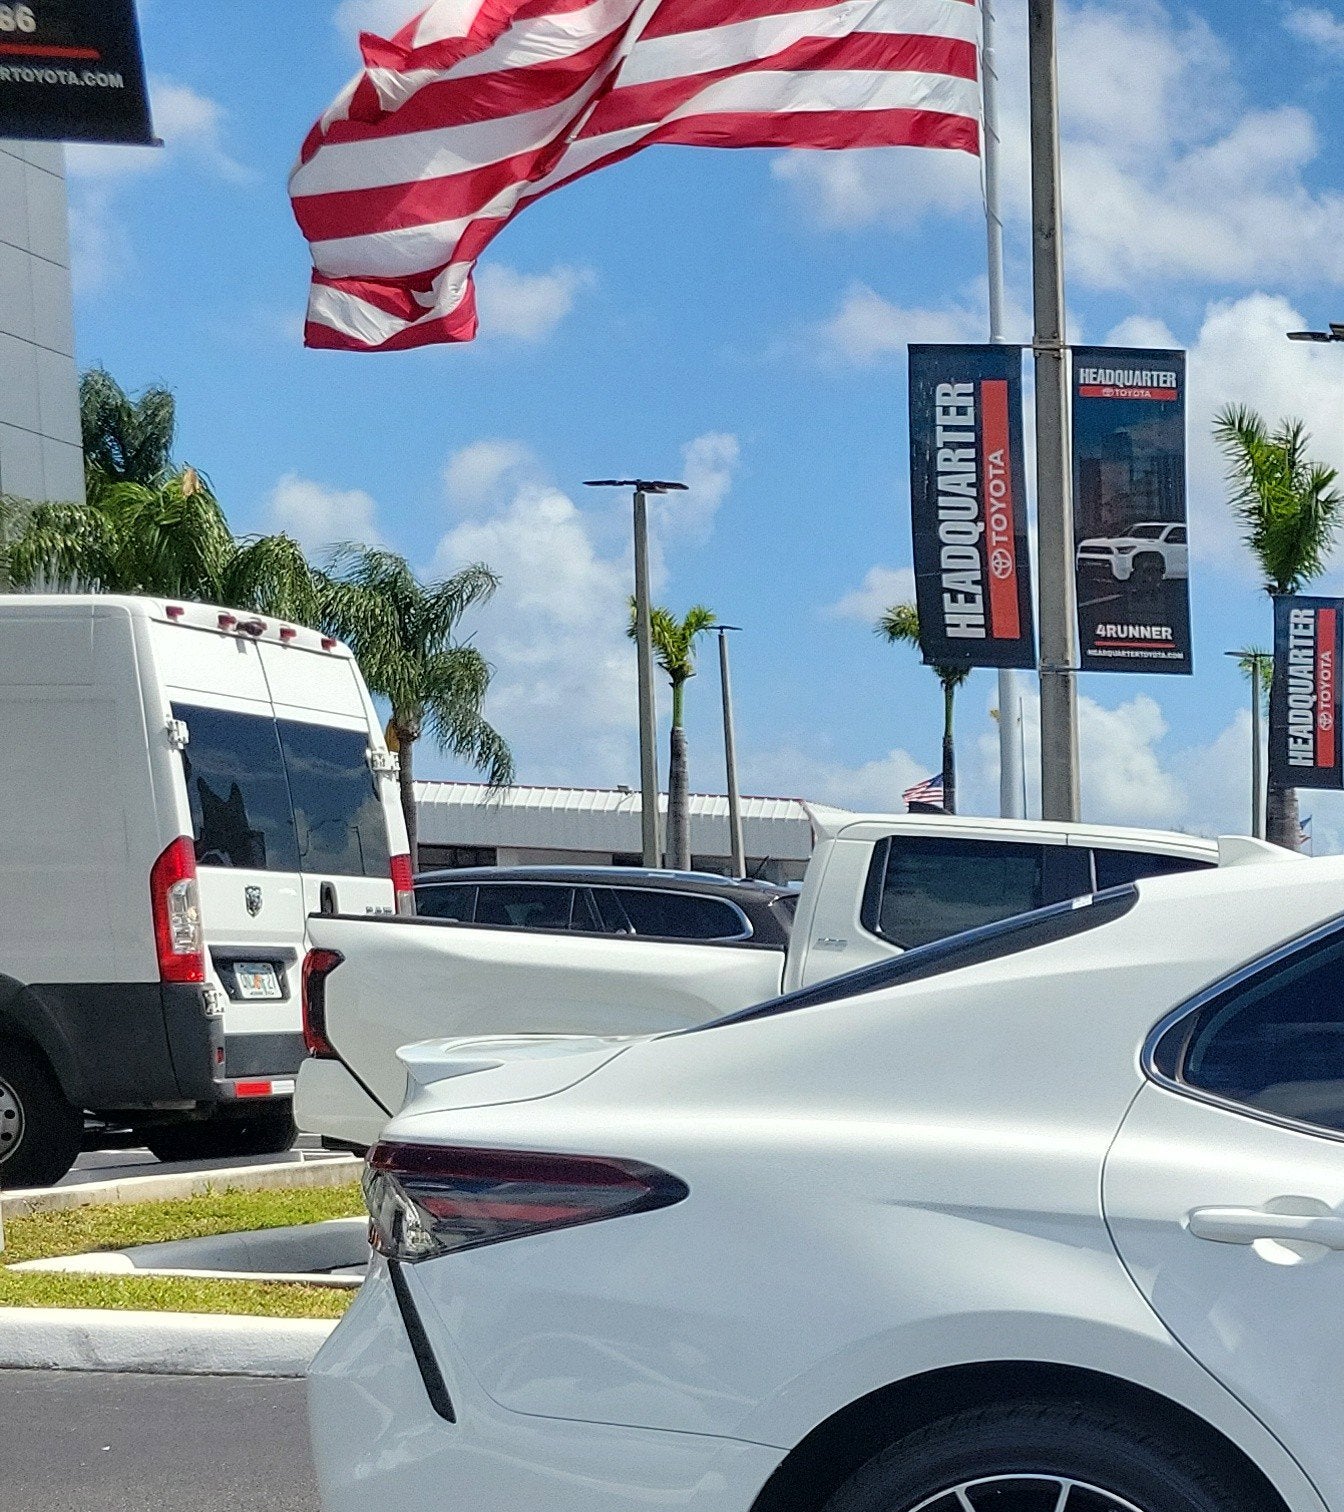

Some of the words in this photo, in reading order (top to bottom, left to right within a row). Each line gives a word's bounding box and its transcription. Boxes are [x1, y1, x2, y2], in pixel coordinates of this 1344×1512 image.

[1079, 368, 1177, 388] HEADQUARTER
[1115, 389, 1151, 397] TOYOTA
[936, 382, 986, 638] HEADQUARTER
[987, 449, 1009, 546] TOYOTA
[1096, 624, 1173, 640] 4RUNNER
[1288, 608, 1317, 766] HEADQUARTER
[1319, 651, 1333, 709] TOYOTA
